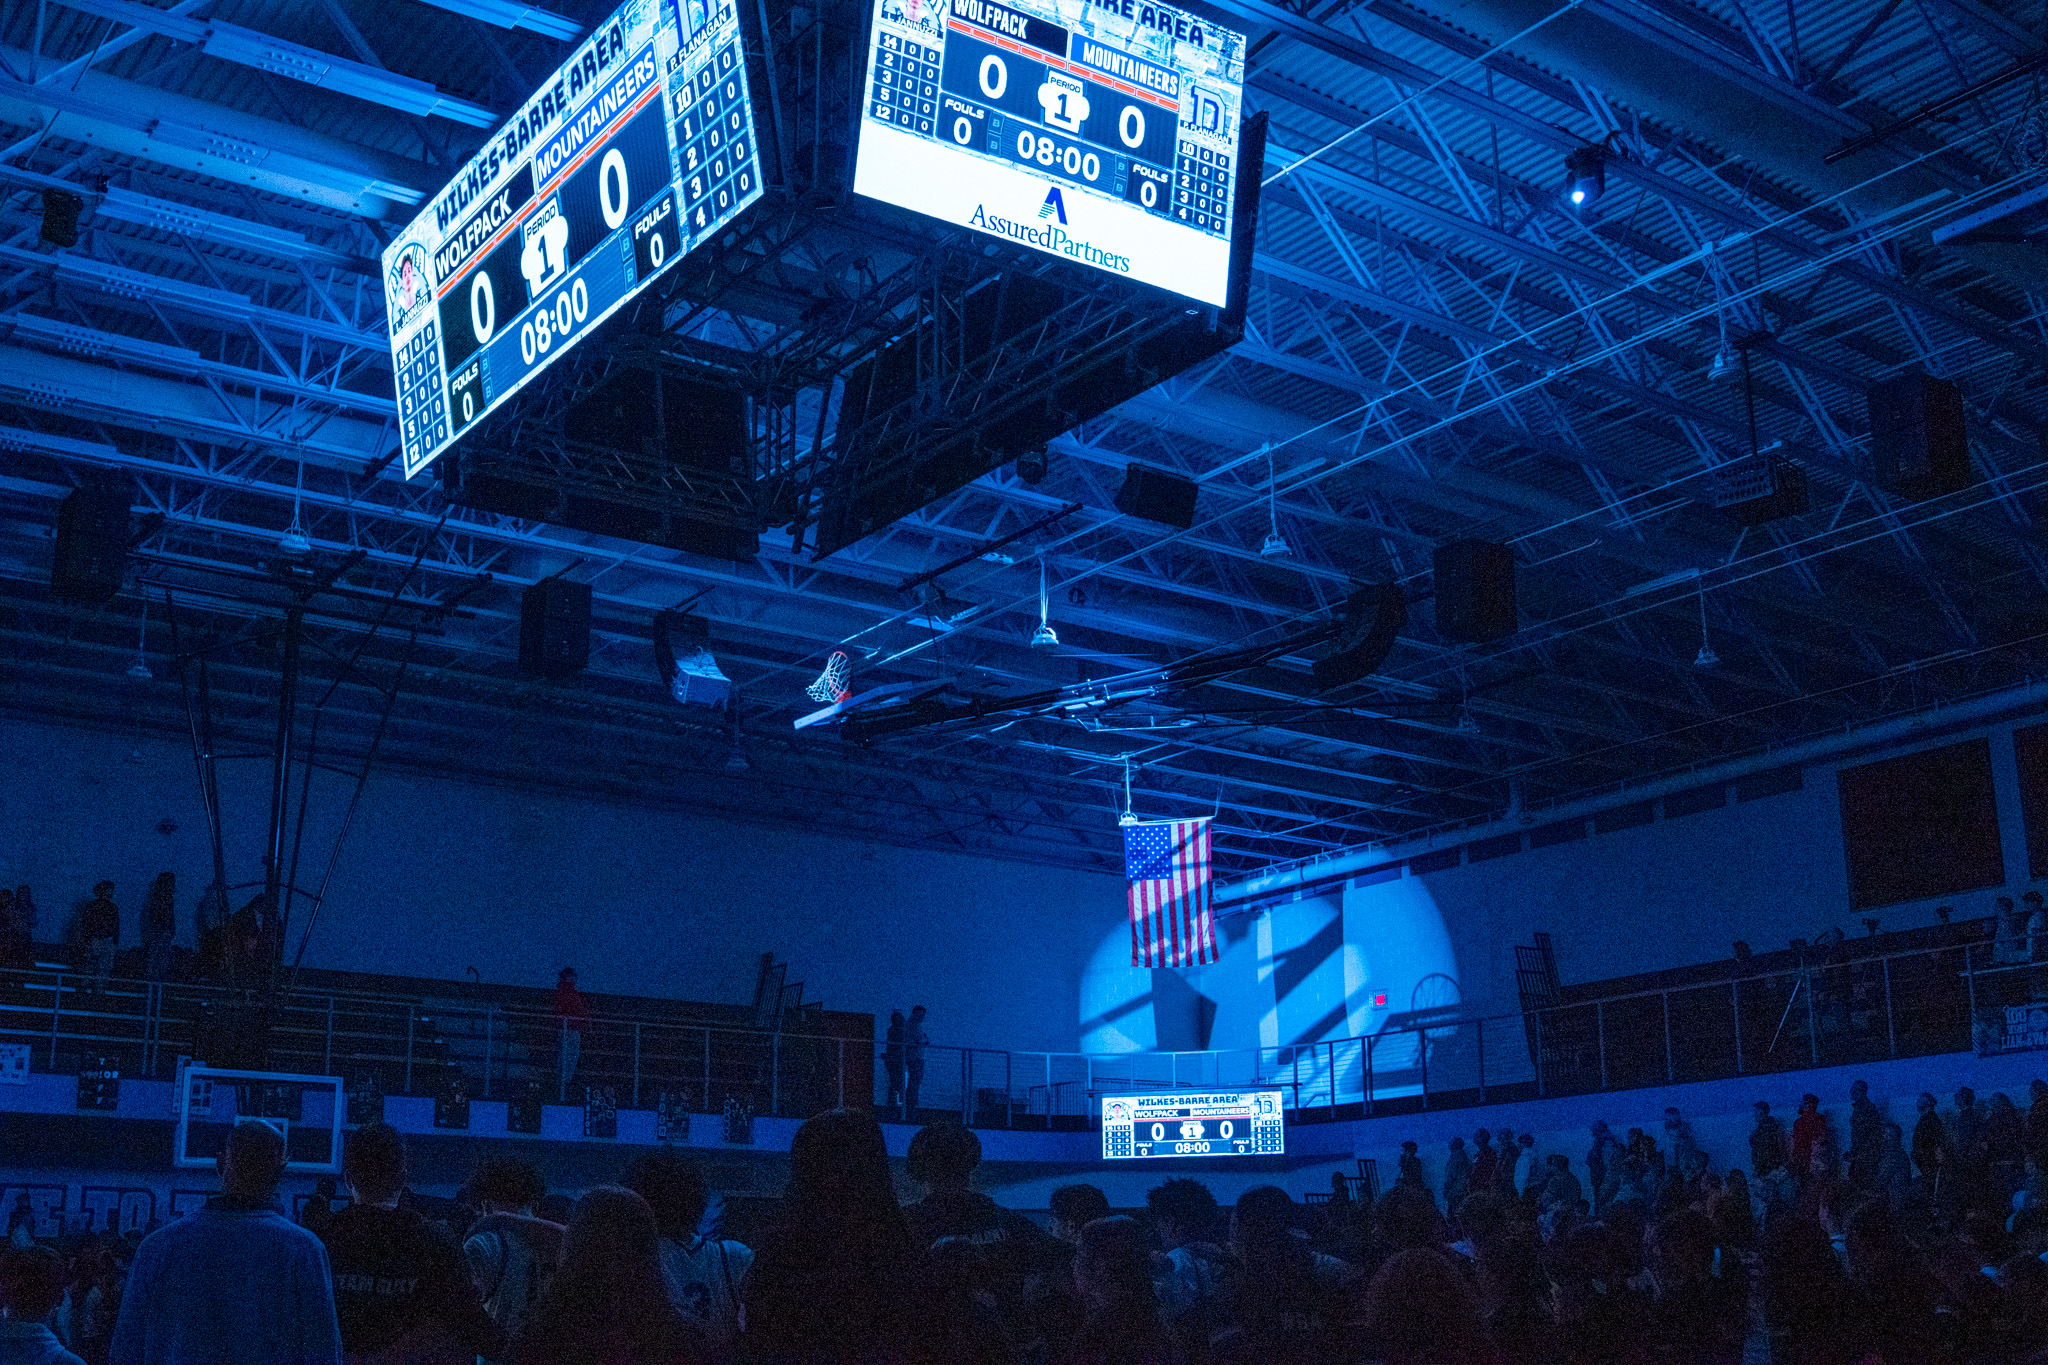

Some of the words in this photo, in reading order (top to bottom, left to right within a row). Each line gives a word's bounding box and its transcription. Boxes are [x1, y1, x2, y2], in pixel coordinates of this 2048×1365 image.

[679, 9, 727, 64] FLANAGAN
[895, 15, 938, 36] JANNUZZI
[954, 0, 1028, 39] WOLFPACK
[1140, 5, 1203, 47] AREA
[884, 34, 898, 50] 14
[910, 44, 916, 54] 0
[928, 52, 936, 62] 0
[884, 52, 894, 66] 2
[908, 62, 914, 72] 0
[926, 68, 934, 78] 0
[676, 86, 692, 114] 10
[702, 70, 710, 88] 0
[722, 52, 730, 68] 0
[882, 70, 892, 84] 3
[906, 80, 912, 90] 0
[924, 86, 932, 96] 0
[979, 55, 1007, 99] 0
[1050, 76, 1080, 94] PERIOD
[1083, 42, 1178, 95] MOUNTAINEERS
[537, 51, 655, 182] MOUNTAINEERS
[684, 118, 692, 140] 1
[706, 100, 714, 118] 0
[728, 82, 734, 100] 0
[876, 104, 890, 120] 12
[902, 114, 908, 124] 0
[920, 120, 928, 130] 0
[880, 88, 890, 102] 5
[904, 96, 910, 106] 0
[922, 104, 930, 114] 0
[945, 99, 984, 119] FOULS
[1054, 93, 1071, 123] 1
[436, 79, 567, 231] WILKES-BARRE
[569, 23, 624, 99] AREA
[686, 146, 698, 170] 2
[710, 130, 718, 148] 0
[732, 112, 740, 130] 0
[954, 117, 971, 145] 0
[1119, 106, 1145, 148] 0
[1190, 123, 1229, 144] FLANAGAN
[690, 176, 702, 200] 3
[716, 160, 724, 178] 0
[736, 142, 744, 160] 0
[1017, 131, 1100, 182] 08:00
[1182, 142, 1194, 156] 10
[1204, 150, 1210, 160] 0
[1220, 156, 1226, 166] 0
[1184, 158, 1190, 172] 1
[1202, 166, 1208, 176] 0
[1218, 172, 1224, 182] 0
[599, 149, 628, 229] 0
[1133, 164, 1168, 183] FOULS
[1182, 174, 1190, 188] 2
[1200, 182, 1206, 192] 0
[1216, 188, 1224, 198] 0
[696, 206, 706, 228] 4
[720, 190, 728, 208] 0
[740, 174, 748, 190] 0
[1141, 181, 1156, 207] 0
[1180, 190, 1188, 204] 3
[1200, 198, 1206, 208] 0
[1216, 204, 1222, 214] 0
[436, 189, 512, 280] WOLFPACK
[527, 203, 556, 240] PERIOD
[635, 198, 670, 240] FOULS
[1178, 208, 1188, 220] 4
[1198, 214, 1204, 224] 0
[1214, 220, 1220, 230] 0
[650, 233, 663, 267] 0
[969, 203, 1130, 272] AssuredPartners
[537, 234, 555, 284] 1
[471, 271, 494, 343] 0
[521, 278, 588, 365] 08:00
[398, 346, 410, 370] 14
[414, 338, 420, 352] 0
[426, 326, 432, 340] 0
[402, 372, 410, 392] 2
[416, 362, 422, 376] 0
[430, 350, 434, 364] 0
[453, 362, 478, 395] FOULS
[406, 396, 412, 414] 3
[420, 386, 426, 400] 0
[432, 376, 438, 390] 0
[463, 392, 473, 421] 0
[408, 420, 416, 438] 5
[422, 410, 428, 424] 0
[436, 400, 440, 414] 0
[410, 444, 420, 464] 12
[426, 436, 430, 448] 0
[438, 424, 444, 438] 0
[1134, 1109, 1179, 1118] WOLFPACK
[1193, 1107, 1249, 1115] MOUNTAINEERS
[1138, 1096, 1210, 1106] WILKES-BARRE
[1213, 1095, 1238, 1104] AREA
[1151, 1123, 1164, 1141] 0
[1189, 1127, 1196, 1137] 1
[1220, 1120, 1233, 1139] 0
[1175, 1141, 1210, 1153] 08:00
[1238, 1145, 1245, 1153] 0
